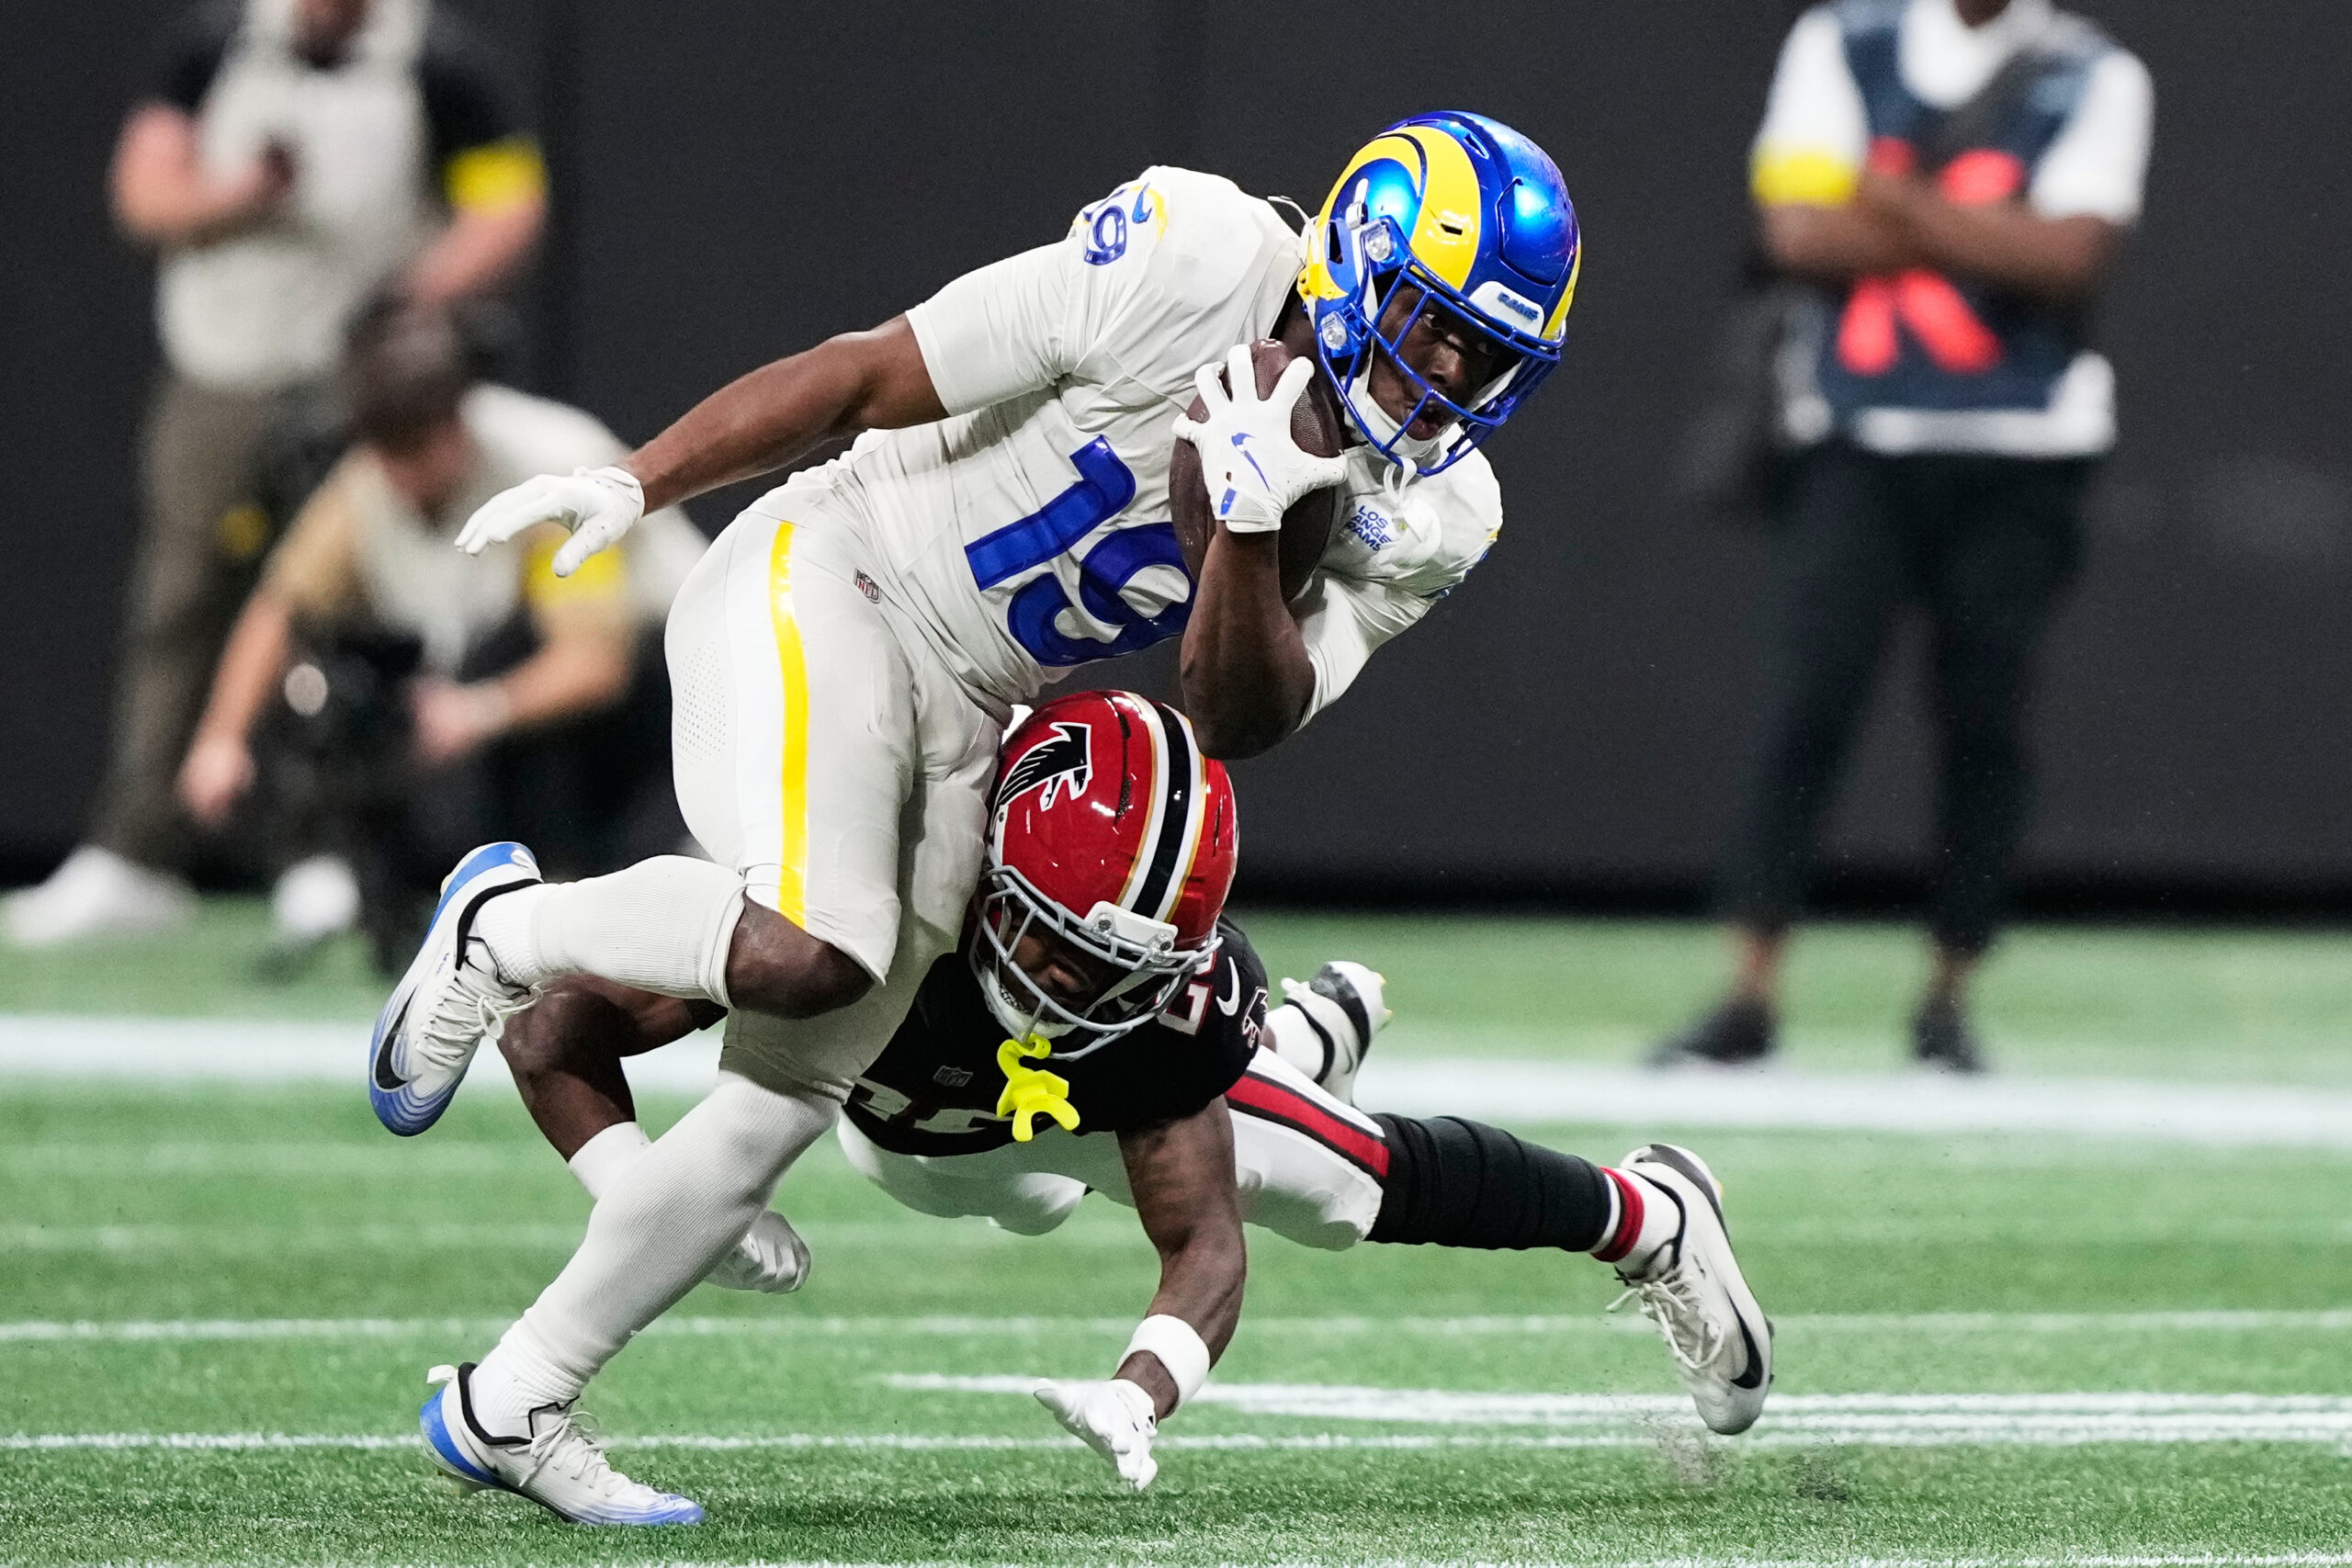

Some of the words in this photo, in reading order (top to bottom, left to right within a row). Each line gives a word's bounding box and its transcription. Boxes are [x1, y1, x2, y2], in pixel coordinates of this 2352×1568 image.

[1351, 514, 1393, 544] ANGE
[1358, 505, 1388, 529] LOS
[965, 434, 1196, 667] 19
[1344, 521, 1381, 551] RAMS
